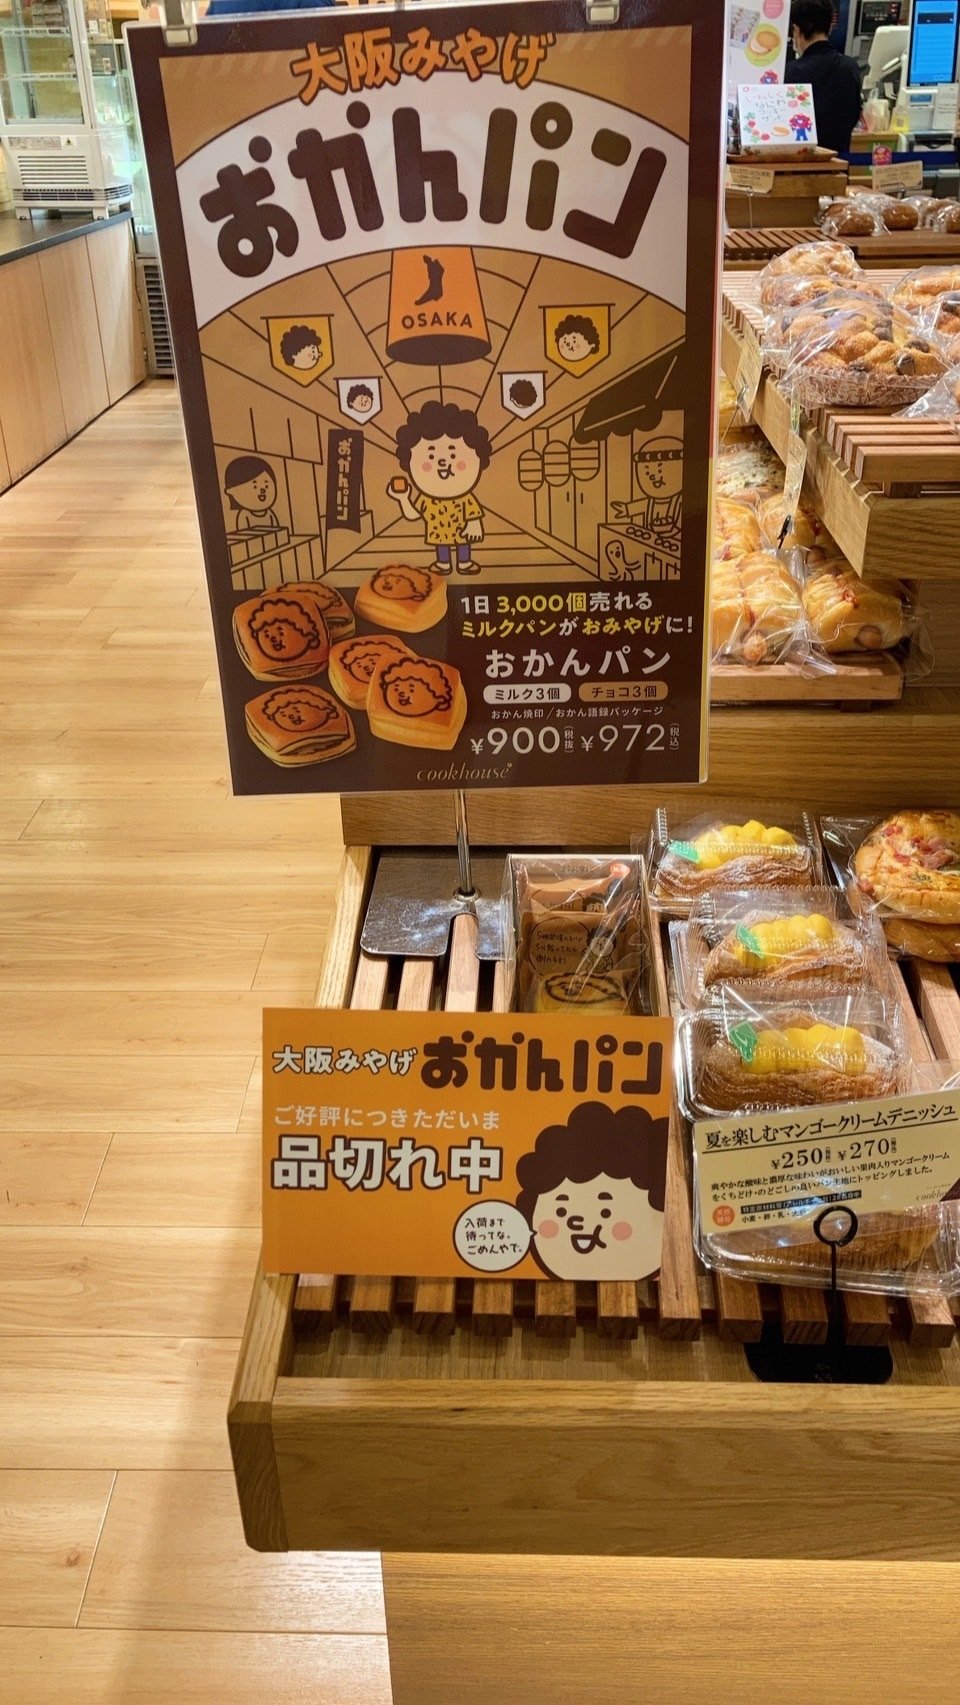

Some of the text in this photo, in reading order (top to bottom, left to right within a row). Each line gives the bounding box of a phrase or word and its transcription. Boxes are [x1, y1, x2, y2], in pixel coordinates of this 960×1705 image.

[290, 27, 556, 104] 大阪みやげ
[199, 101, 668, 278] おかんパン
[401, 312, 473, 330] OSAKA
[336, 437, 353, 521] おかんパン
[462, 614, 694, 638] ミルクパンがおみやげに!
[485, 645, 671, 678] おかんパン
[494, 685, 657, 701] ミルク3個 チョコ3個
[416, 762, 510, 781] cookhouse
[272, 1030, 664, 1095] 大阪みやげ おかんパン
[274, 1104, 501, 1131] ご好評につきただいま
[705, 1103, 956, 1149] 夏を楽しむマンゴークリームデニッシュ
[270, 1134, 503, 1195] 品切れ中
[771, 1147, 824, 1170] ¥250
[837, 1137, 891, 1161] ¥270
[465, 1217, 505, 1229] 入荷まで
[466, 1231, 511, 1242] 待ってな。
[467, 1243, 522, 1255] ごめんやで。
